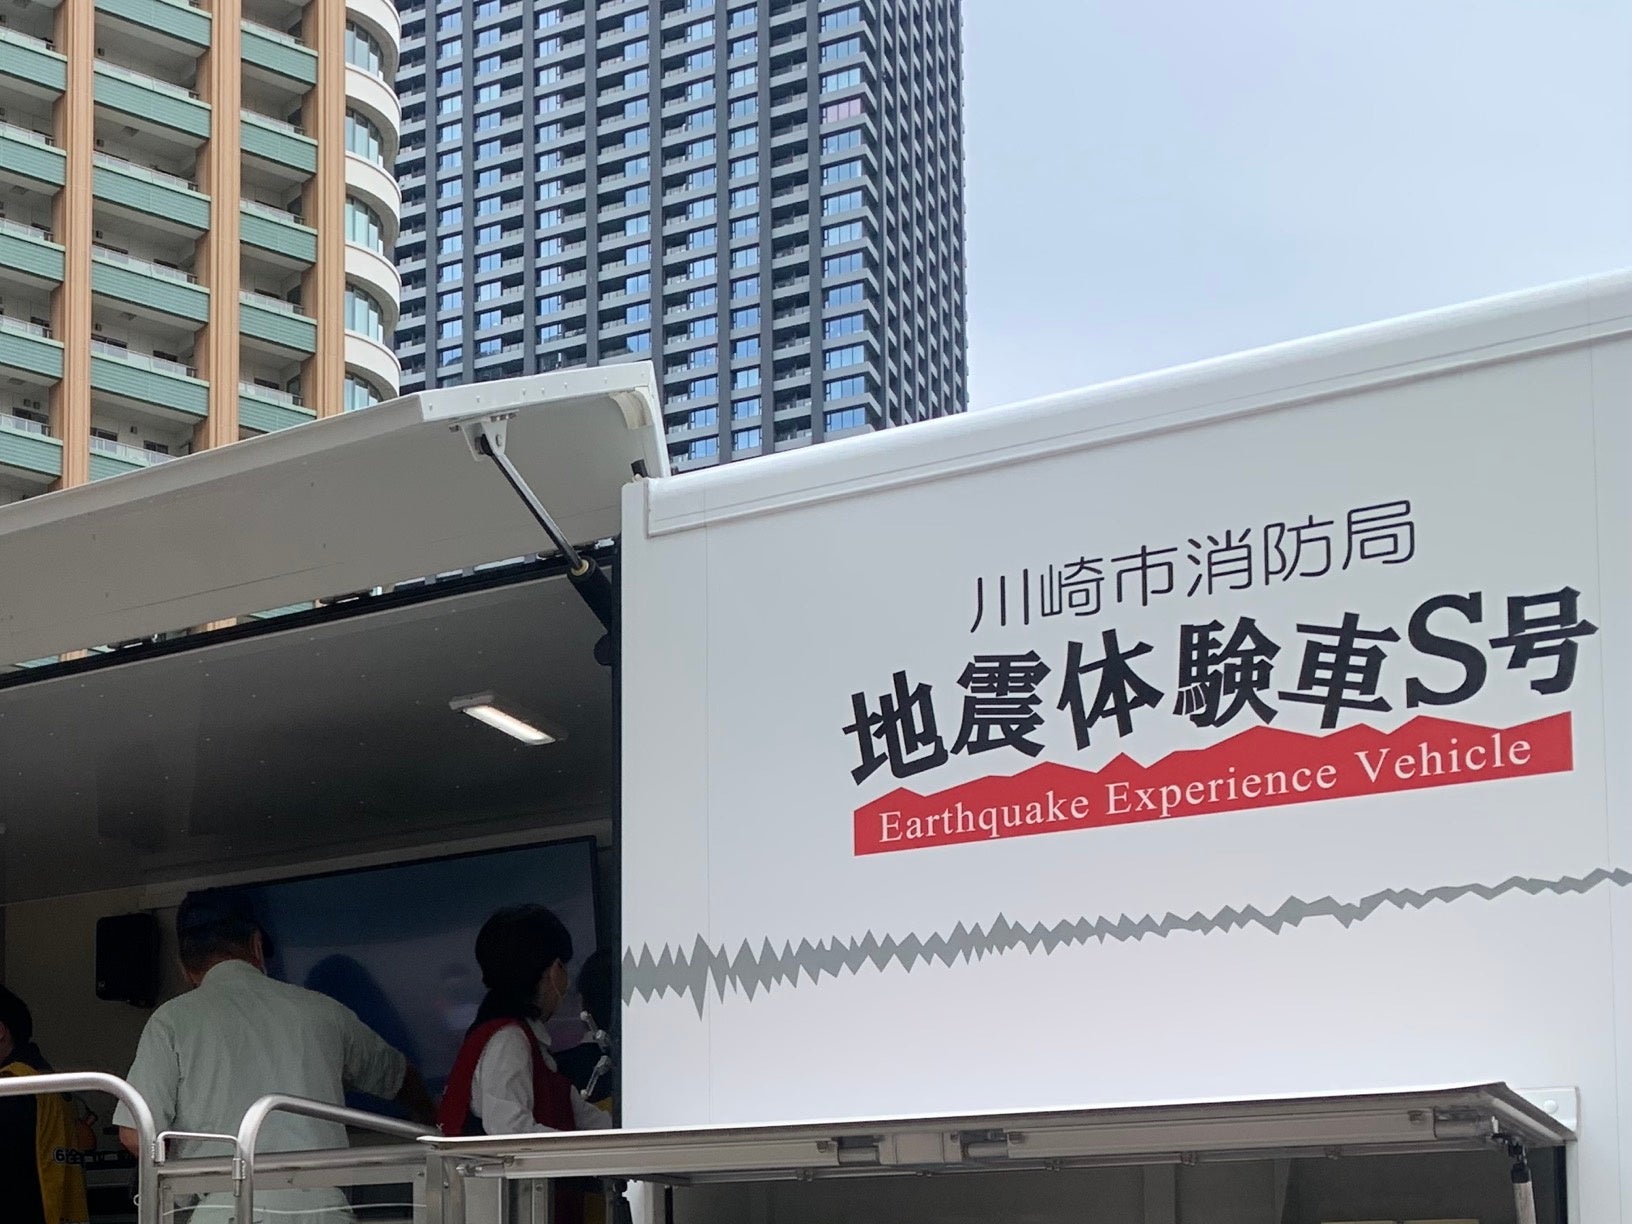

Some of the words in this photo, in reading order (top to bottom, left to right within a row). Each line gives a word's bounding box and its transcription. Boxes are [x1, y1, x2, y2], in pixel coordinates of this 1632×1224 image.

[971, 499, 1416, 633] 川崎市消防局
[842, 586, 1599, 786] 地震体験車S号
[878, 790, 1090, 843] Earthquake
[1105, 762, 1337, 818] Experience
[1354, 732, 1532, 783] Vehicle
